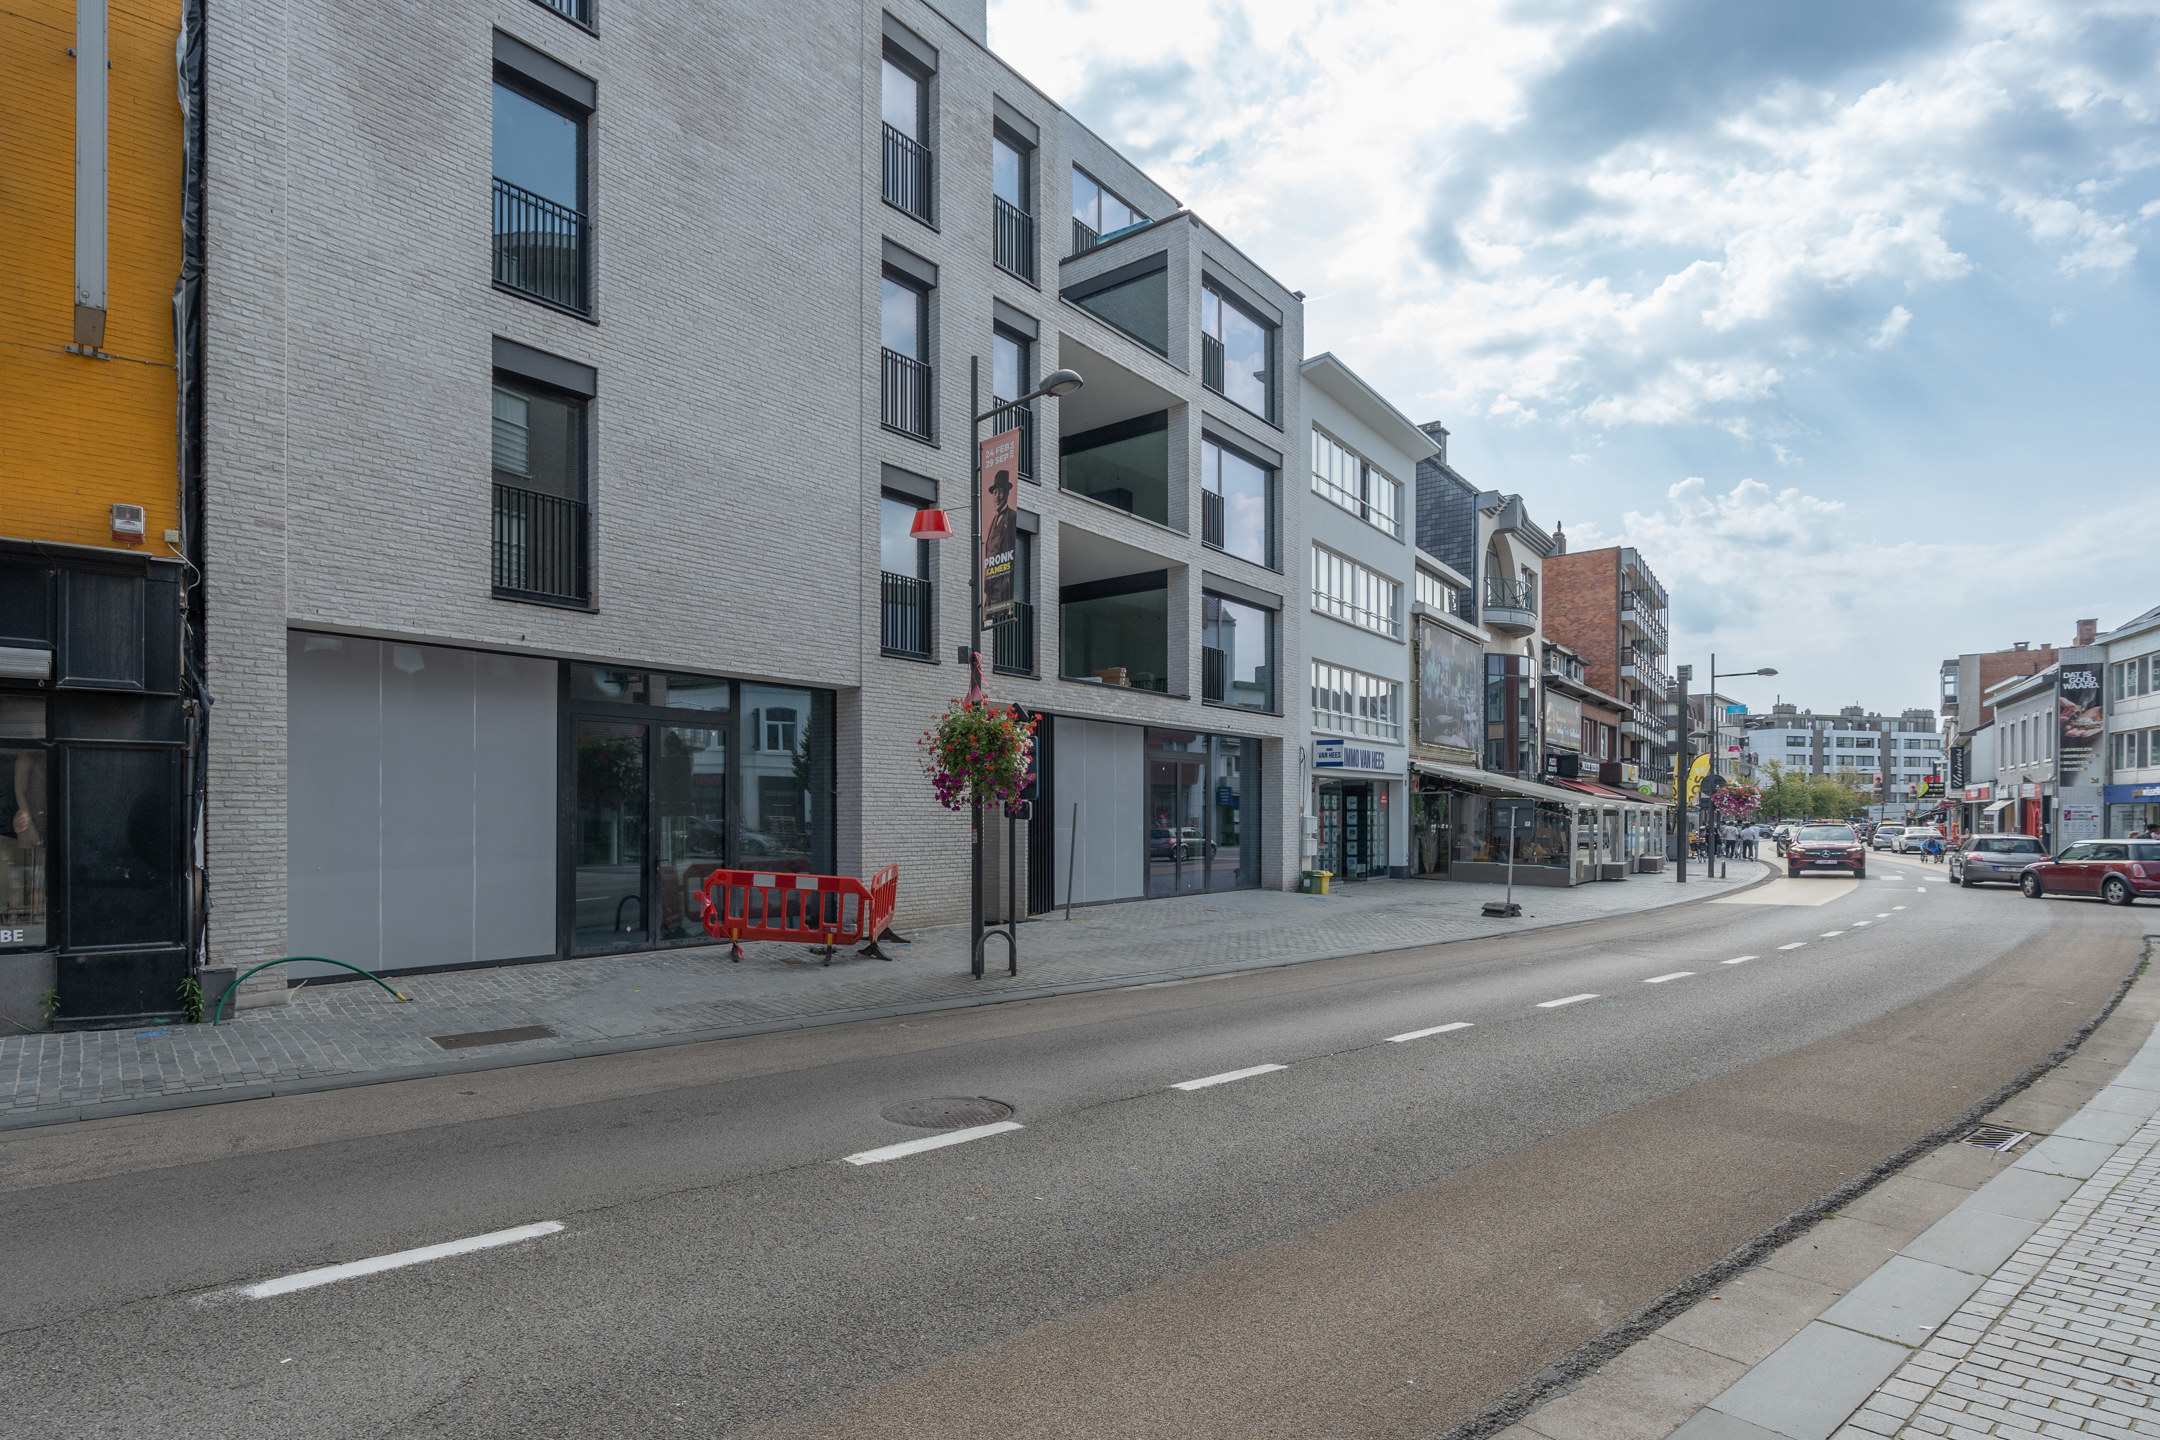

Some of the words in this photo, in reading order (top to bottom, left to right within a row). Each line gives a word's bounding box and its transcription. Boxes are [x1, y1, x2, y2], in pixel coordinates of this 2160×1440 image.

[985, 449, 994, 459] 24
[995, 443, 1010, 455] FEB
[985, 458, 994, 469] 29
[995, 453, 1009, 465] SEP
[984, 549, 1014, 568] PRONK
[986, 562, 1011, 577] KAMERS
[1344, 748, 1359, 768] IMMO
[1360, 750, 1371, 769] VAN
[1372, 751, 1384, 770] HEES
[0, 929, 24, 943] BE
